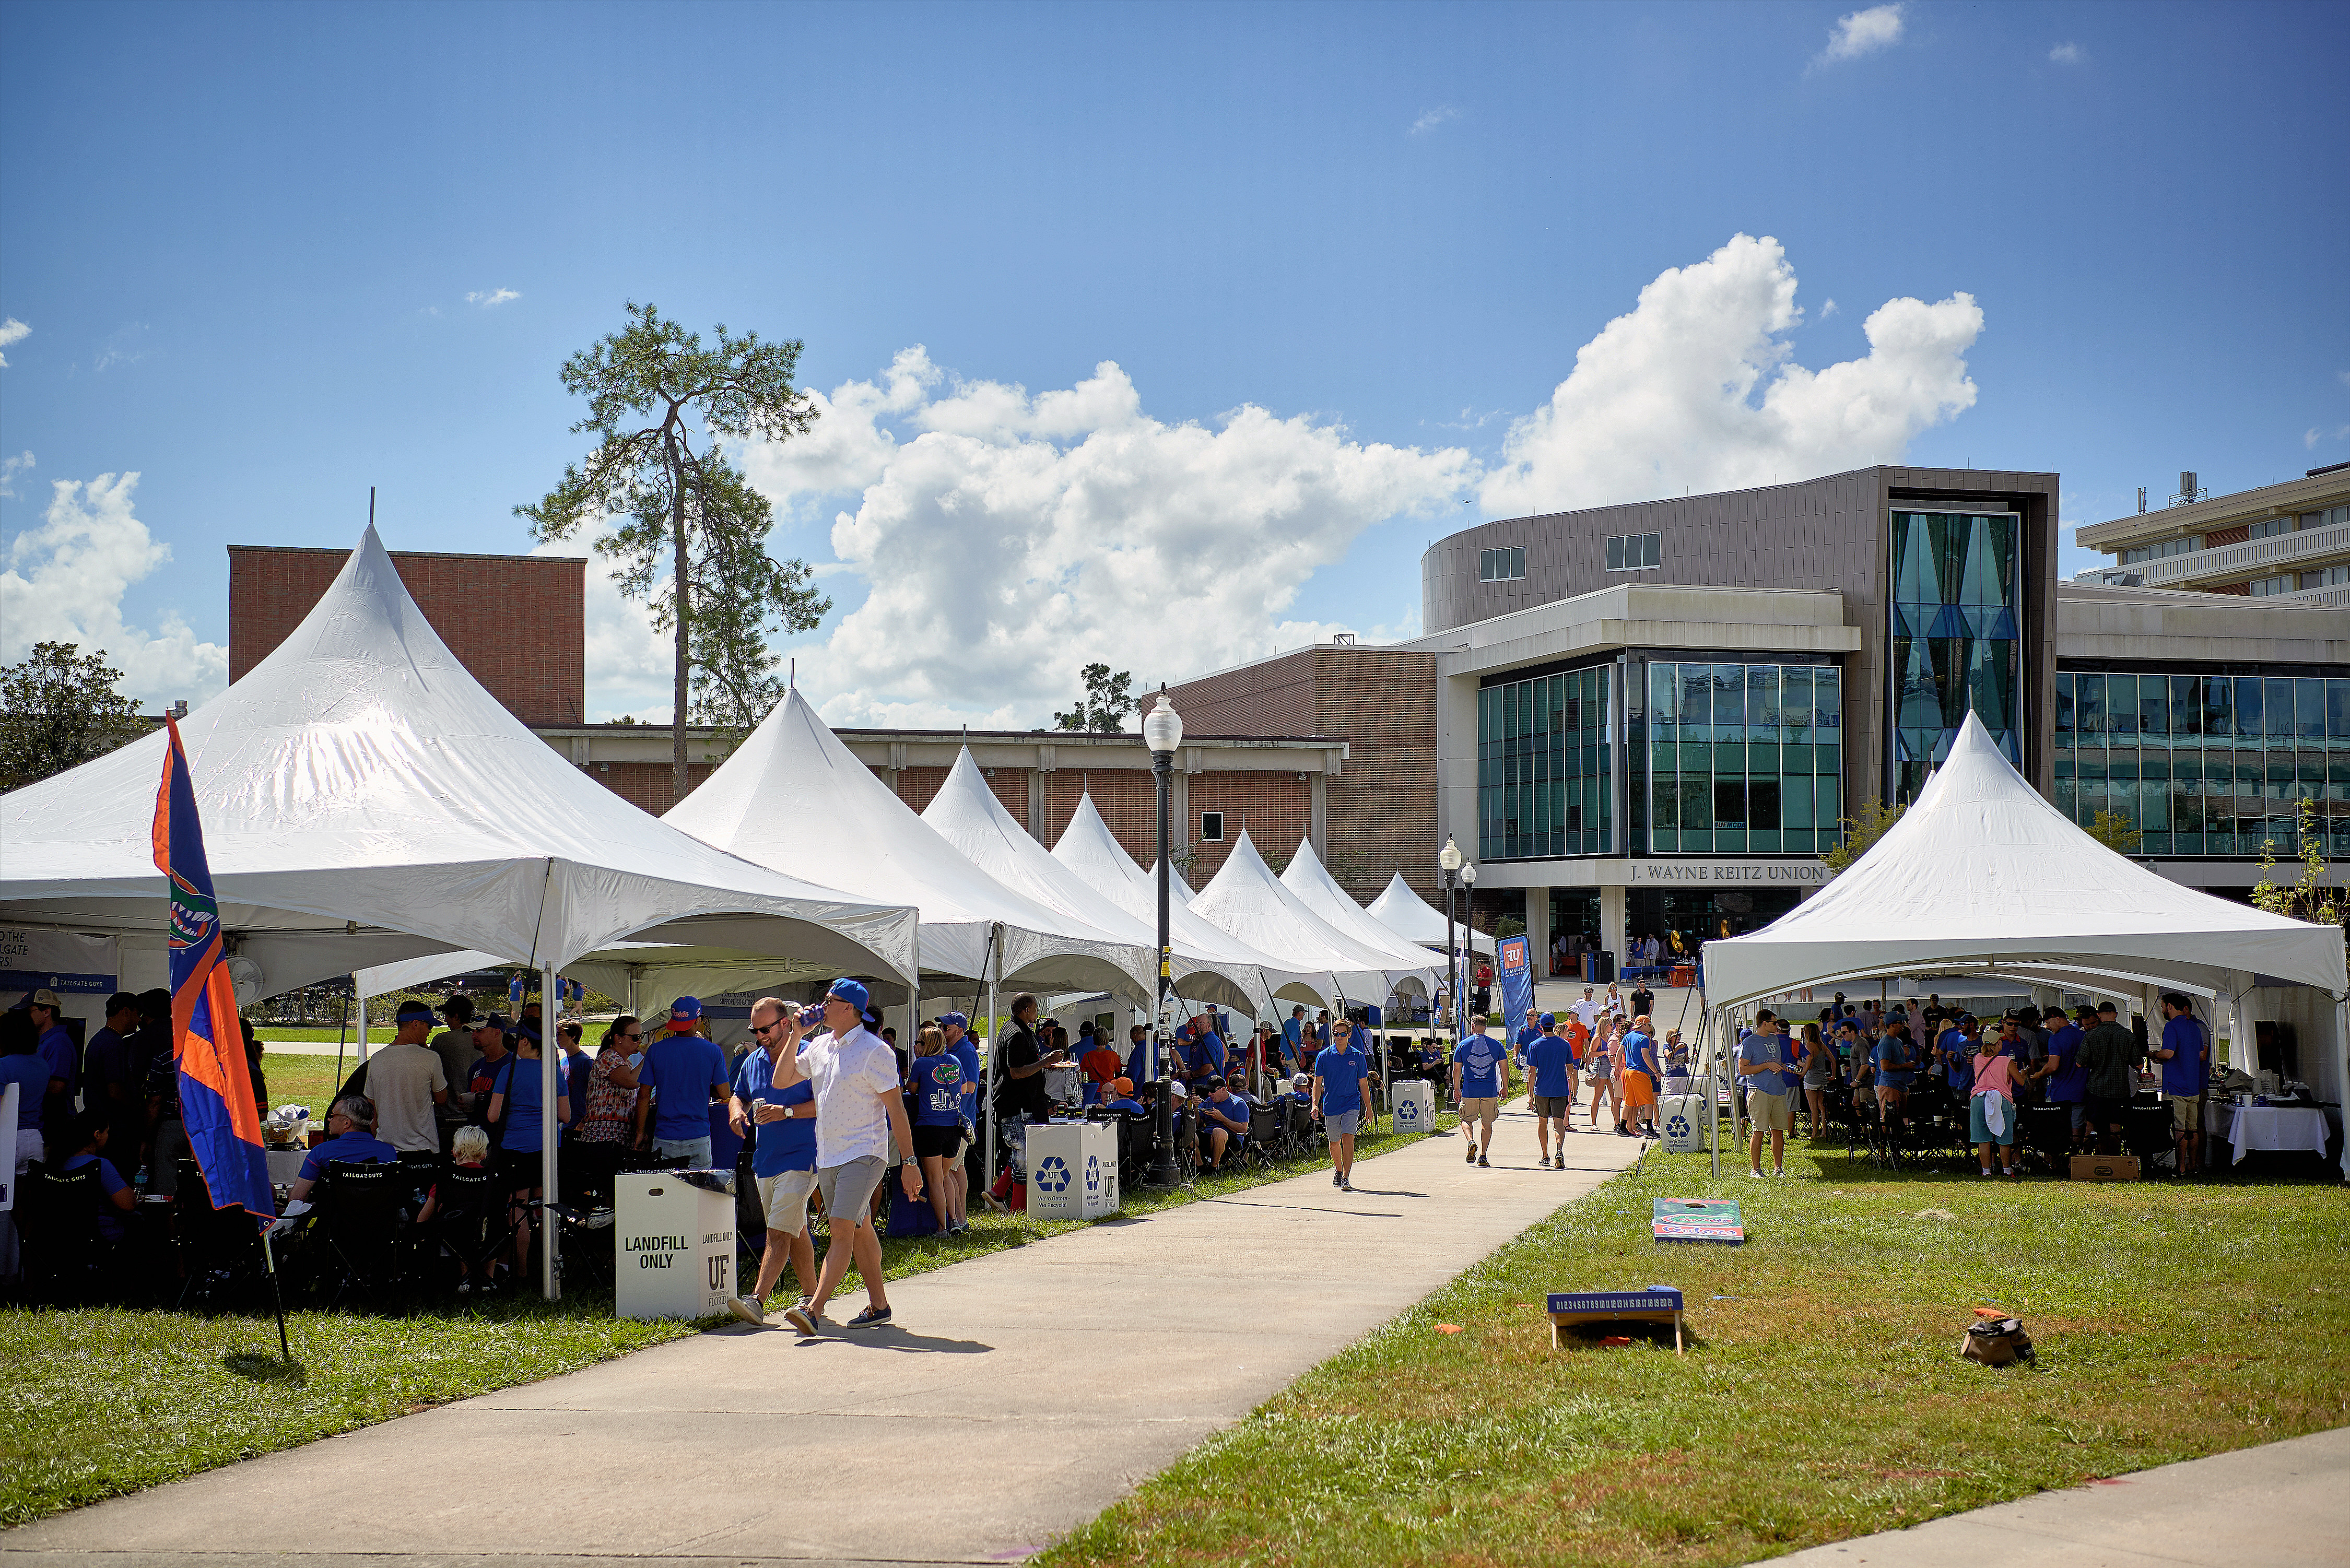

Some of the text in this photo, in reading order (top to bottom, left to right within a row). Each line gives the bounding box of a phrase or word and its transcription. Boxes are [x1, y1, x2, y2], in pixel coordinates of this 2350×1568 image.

[1631, 866, 1824, 881] J. WAYNE REITZ UNION
[8, 931, 26, 942] THE
[453, 1174, 481, 1182] TAILGATE
[1104, 1176, 1115, 1197] UF
[1662, 1225, 1737, 1235] Gators
[625, 1235, 689, 1252] LANDFILL
[702, 1231, 733, 1244] LANDFILL ONLY
[640, 1254, 674, 1269] ONLY
[708, 1254, 729, 1291] UF
[1557, 1301, 1560, 1310] 0
[1564, 1301, 1568, 1309] 2
[1569, 1301, 1572, 1309] 3
[1573, 1300, 1577, 1309] 4
[1577, 1300, 1581, 1309] 5
[1582, 1300, 1585, 1308] 6
[1586, 1300, 1590, 1308] 7
[1591, 1300, 1595, 1308] 8
[1595, 1300, 1599, 1308] 9
[1600, 1300, 1605, 1308] 10
[1606, 1300, 1611, 1308] 11
[1611, 1299, 1617, 1308] 12
[1617, 1299, 1623, 1308] 13
[1623, 1299, 1629, 1307] 14
[1629, 1299, 1635, 1307] 15
[1636, 1299, 1641, 1307] 16
[1642, 1299, 1647, 1307] 17
[1648, 1299, 1653, 1307] 18
[1654, 1299, 1660, 1307] 19
[1660, 1298, 1667, 1307] 20
[1667, 1298, 1673, 1306] 21
